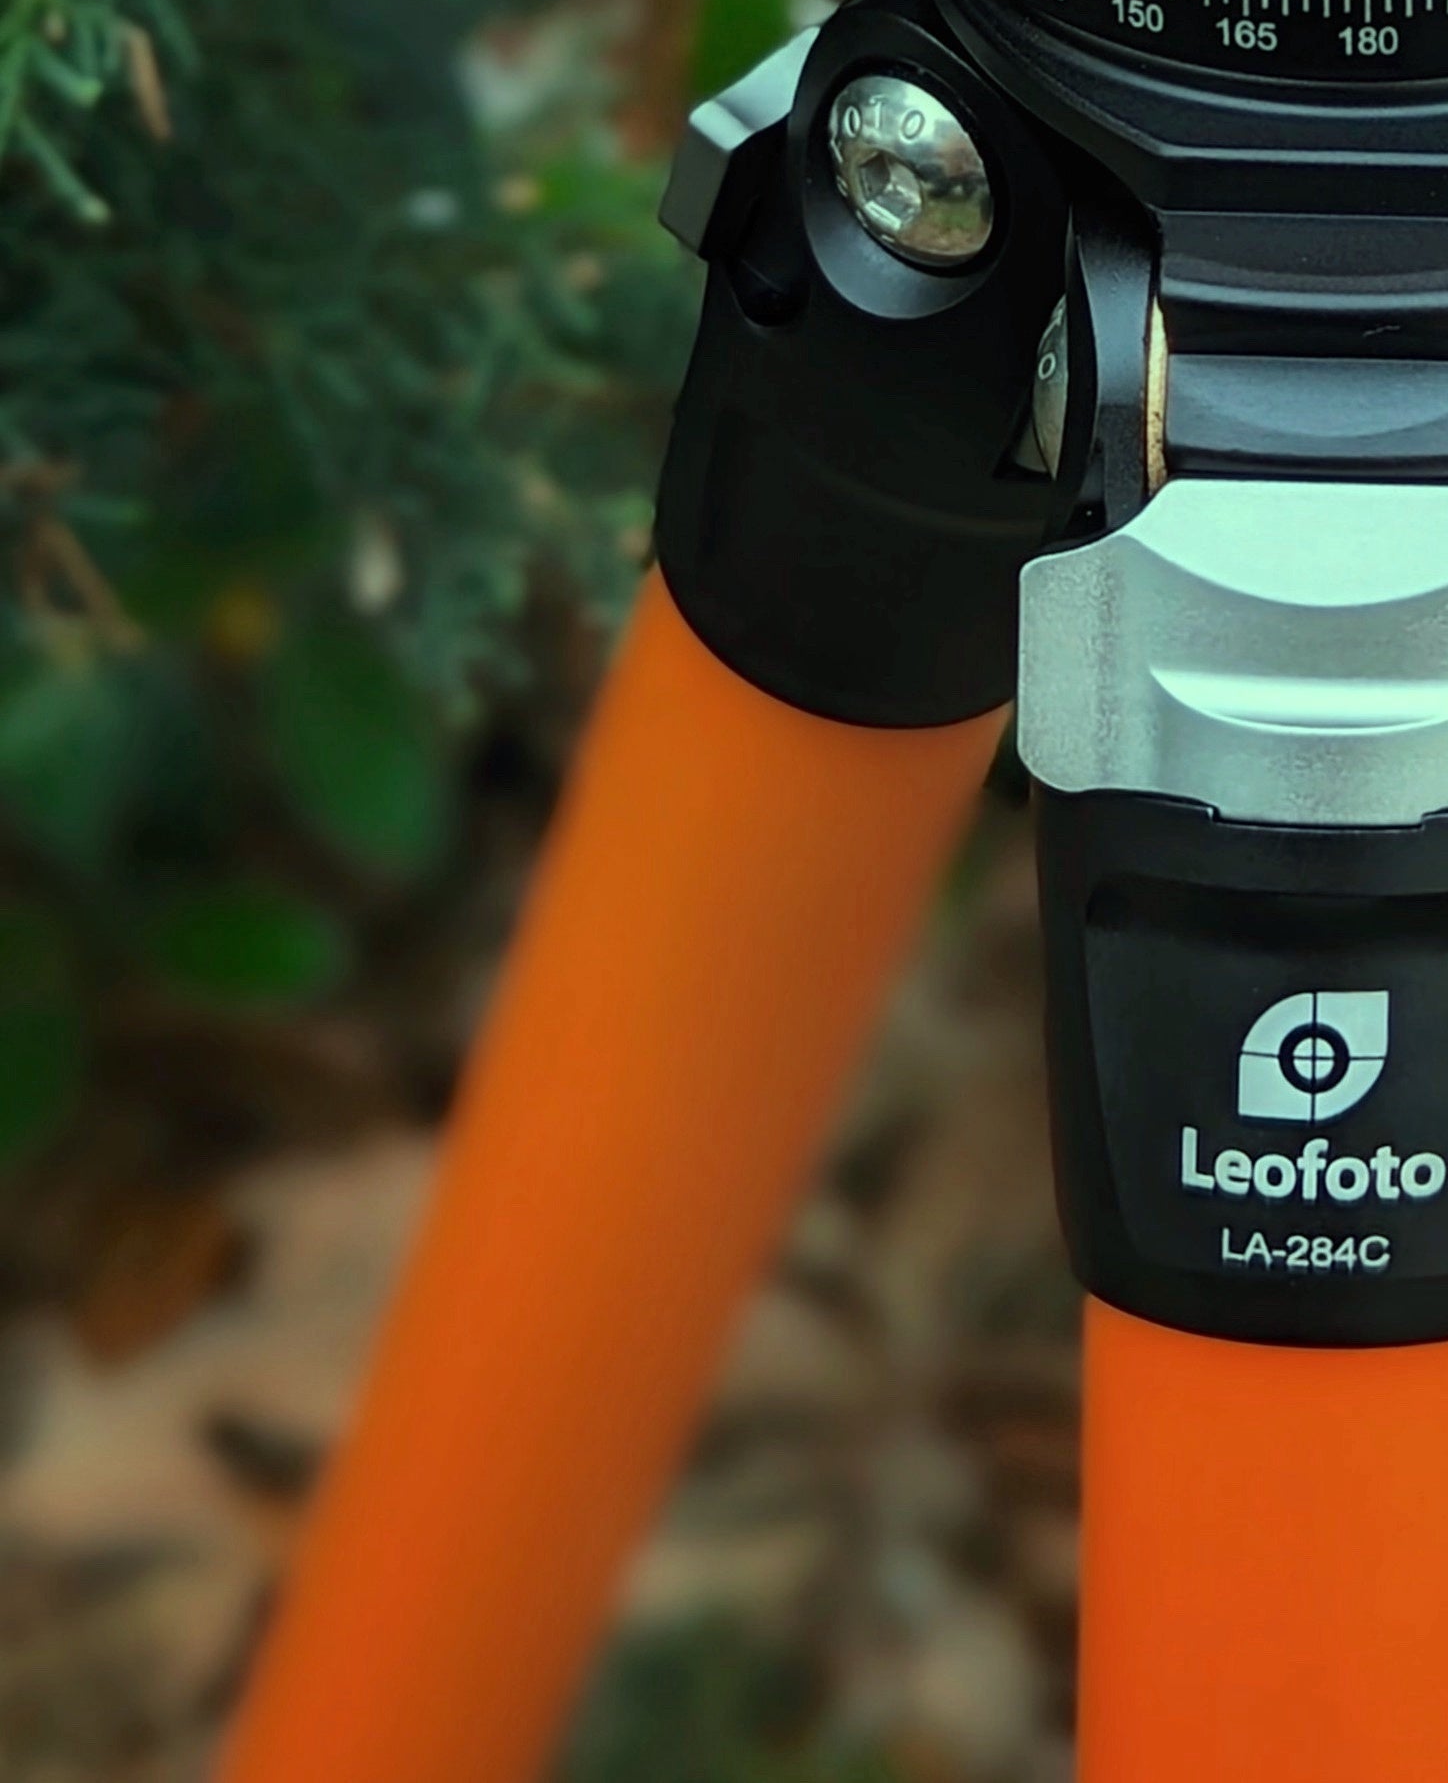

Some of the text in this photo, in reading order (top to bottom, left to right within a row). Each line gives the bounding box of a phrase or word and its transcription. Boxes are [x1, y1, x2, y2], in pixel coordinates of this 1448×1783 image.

[1215, 18, 1278, 53] 165
[1337, 25, 1399, 57] 180
[1180, 1125, 1447, 1201] Leofoto
[1221, 1227, 1391, 1270] LA-284C
